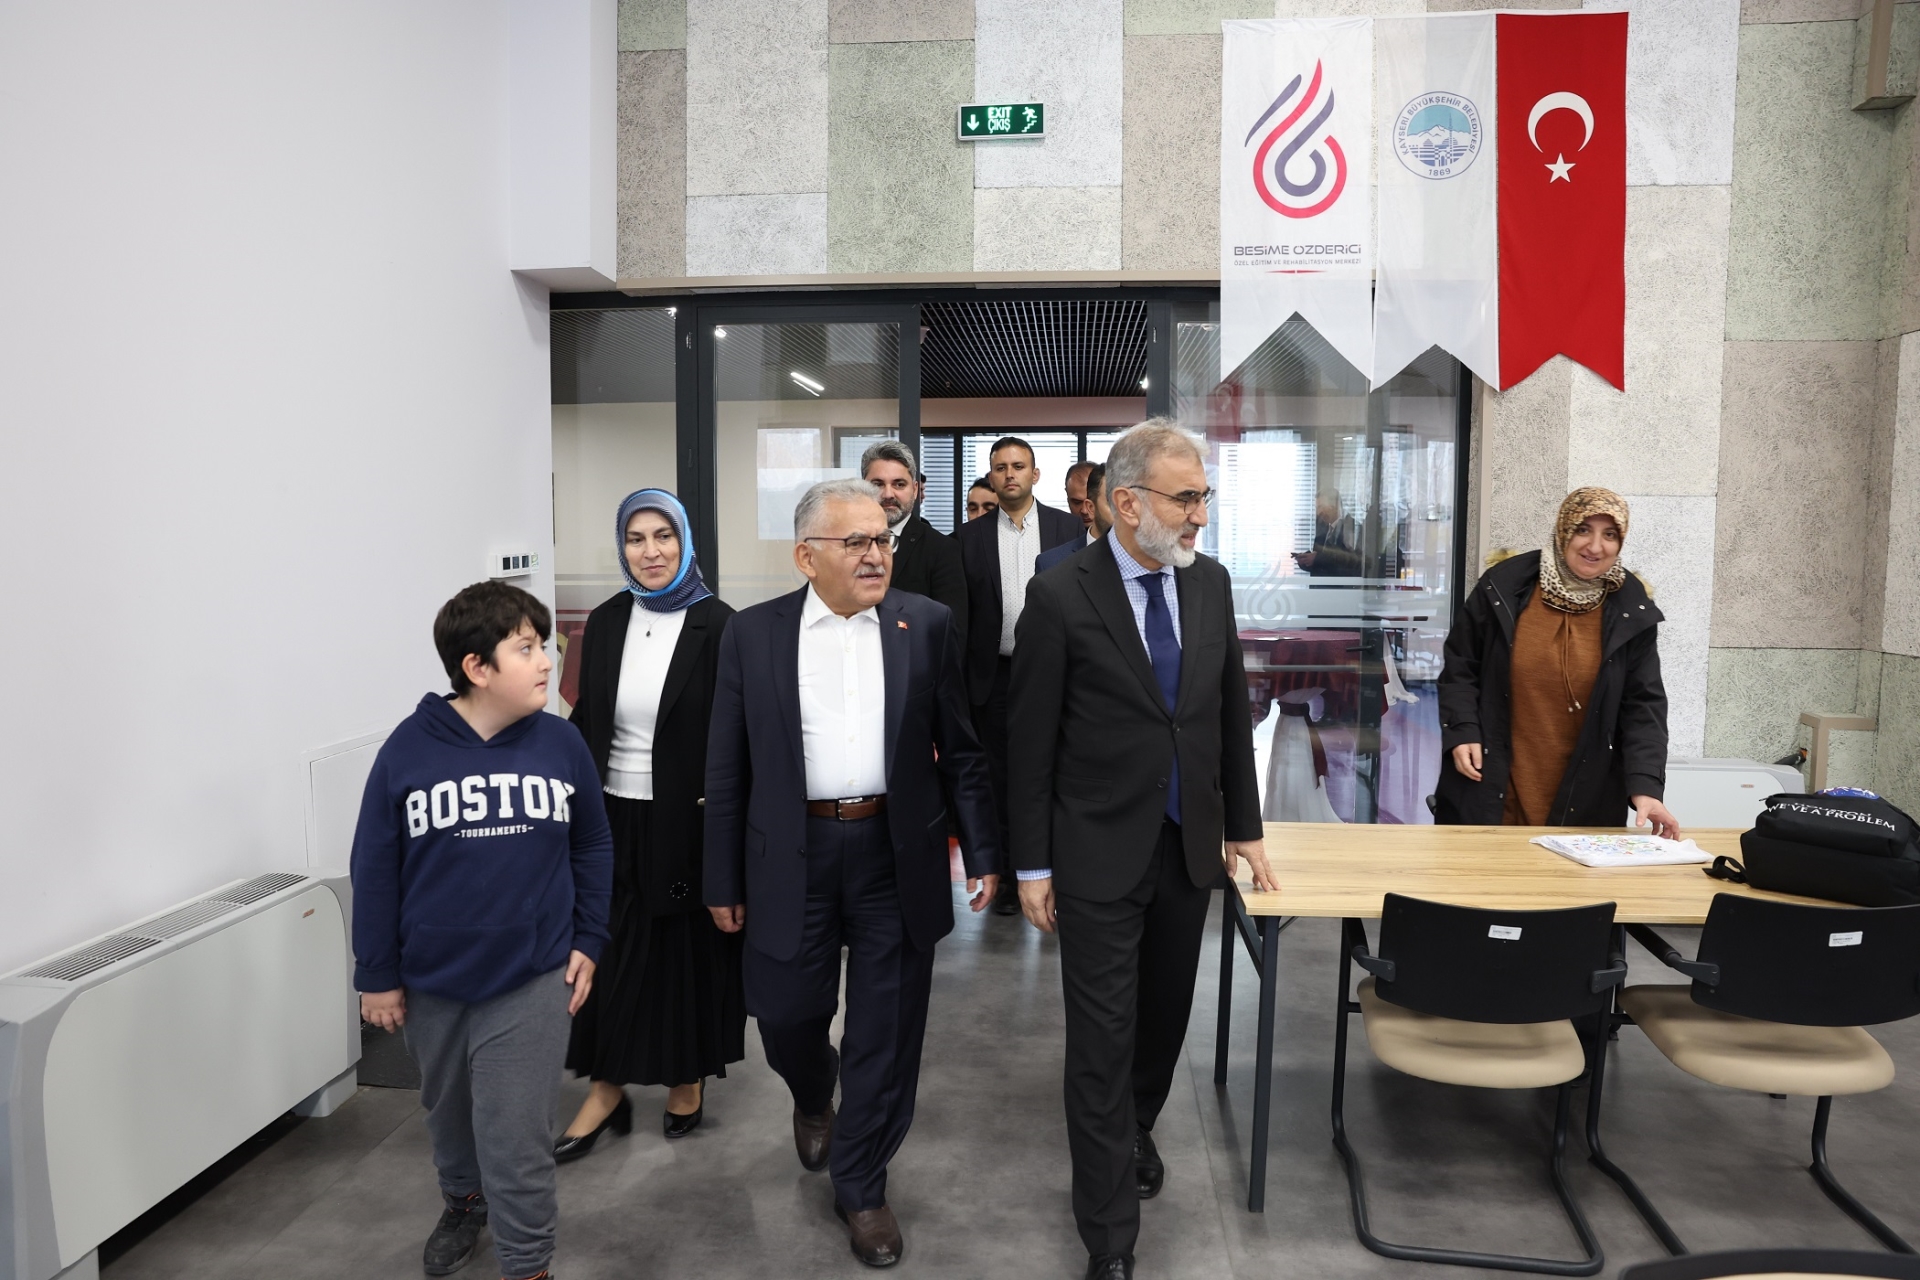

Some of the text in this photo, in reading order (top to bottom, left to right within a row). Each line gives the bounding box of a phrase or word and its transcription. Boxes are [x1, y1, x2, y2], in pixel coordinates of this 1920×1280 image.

[987, 106, 1012, 119] EXIT
[987, 118, 1011, 134] ÇIKIŞ
[1428, 168, 1451, 177] 1869
[405, 773, 576, 839] BOSTON
